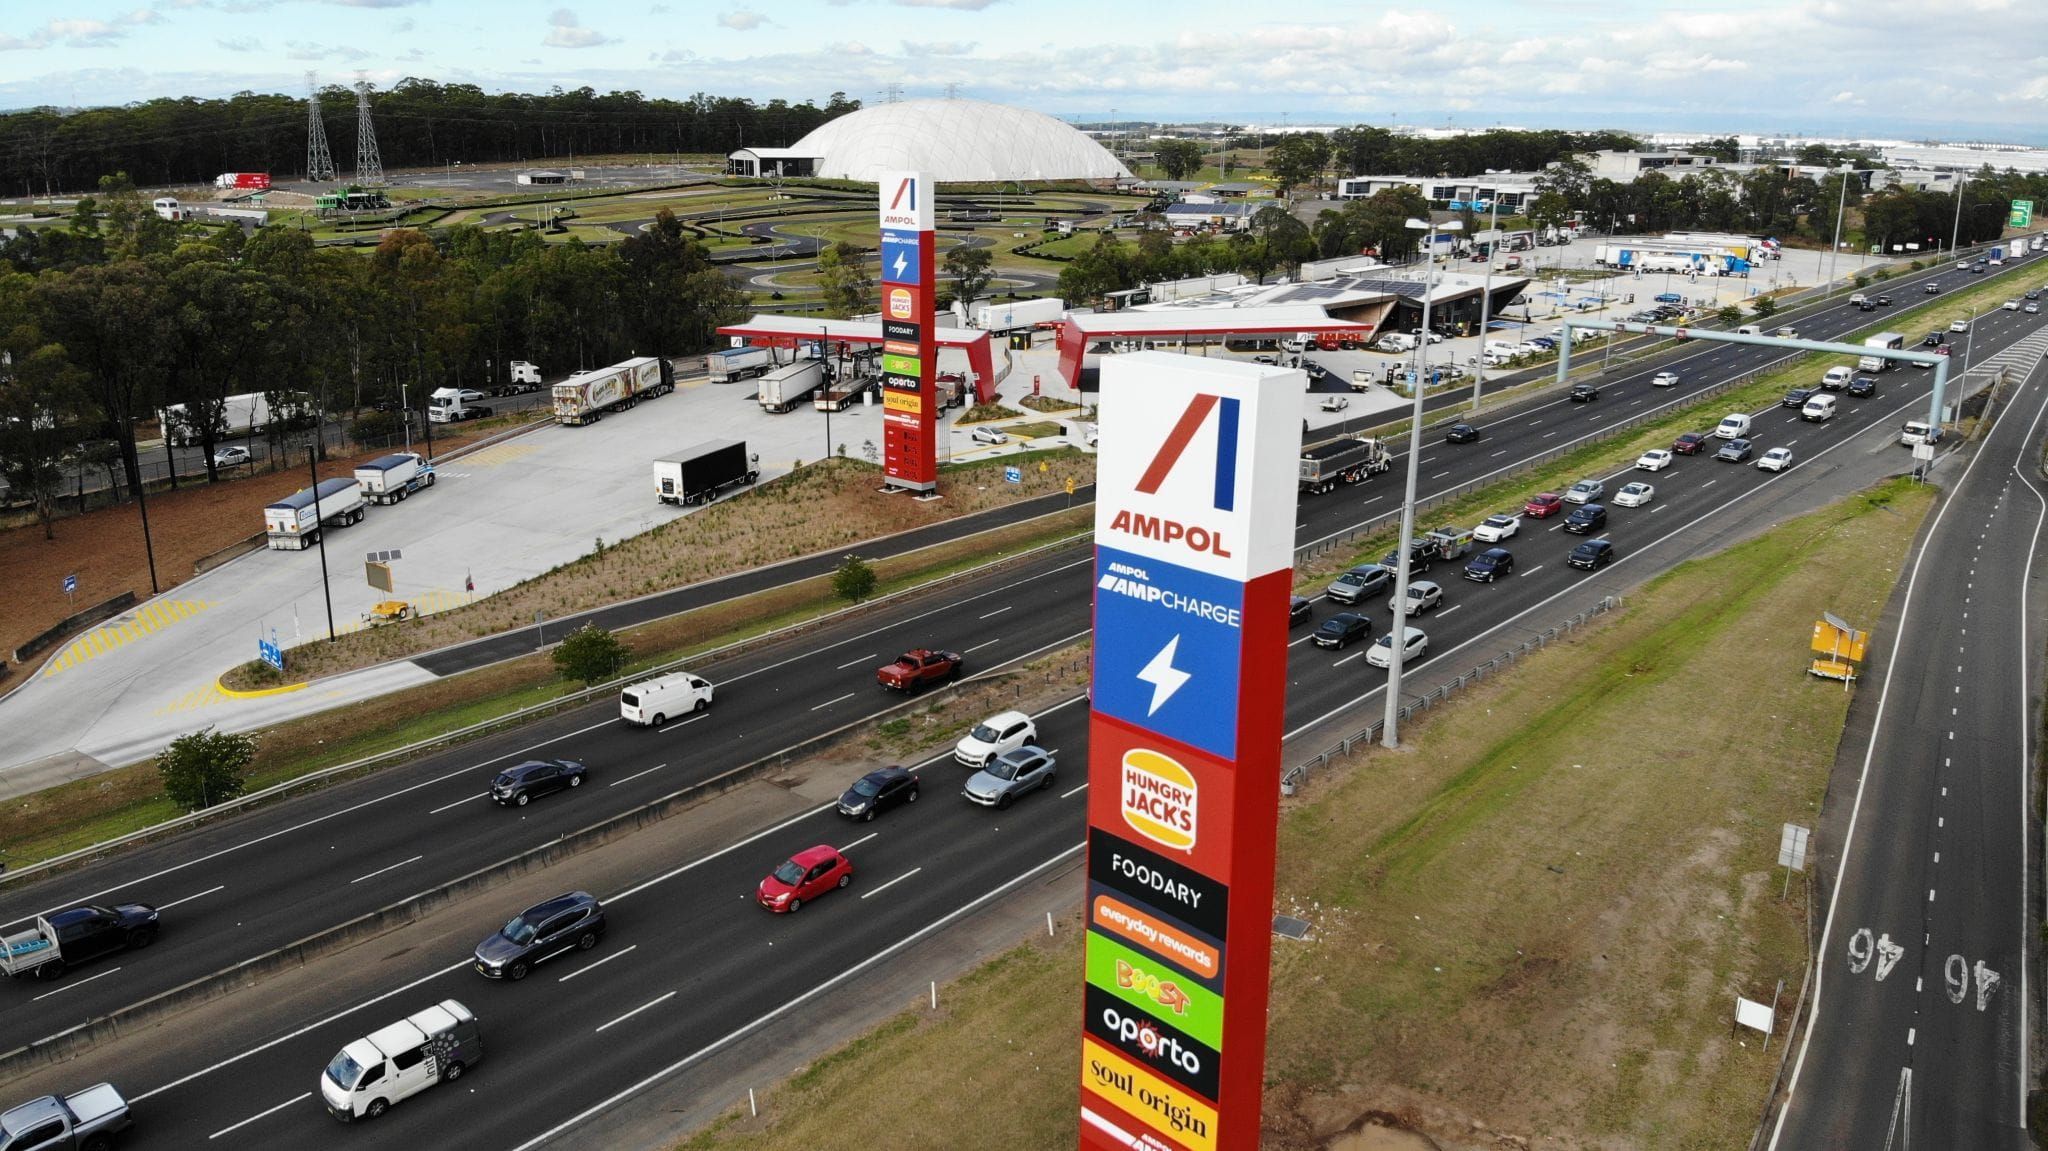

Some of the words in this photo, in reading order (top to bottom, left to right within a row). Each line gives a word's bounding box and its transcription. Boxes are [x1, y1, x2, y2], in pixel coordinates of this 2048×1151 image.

[884, 215, 916, 225] AMPOL
[888, 325, 914, 336] FOODARY
[888, 376, 916, 388] oporto
[899, 399, 919, 409] origin
[1110, 510, 1231, 558] AMPOL
[1108, 562, 1149, 580] AMPOL
[1113, 578, 1240, 627] AMPCHARGE
[1126, 769, 1192, 806] HUNGRY
[1126, 788, 1192, 831] JACK'S
[1113, 853, 1201, 908] FOODARY
[1100, 905, 1158, 942] everyday
[1158, 932, 1212, 968] rewards
[1116, 959, 1190, 1015] BOOST
[1103, 1008, 1200, 1074] oporto
[1090, 1059, 1133, 1096] soul
[1138, 1087, 1207, 1138] origin
